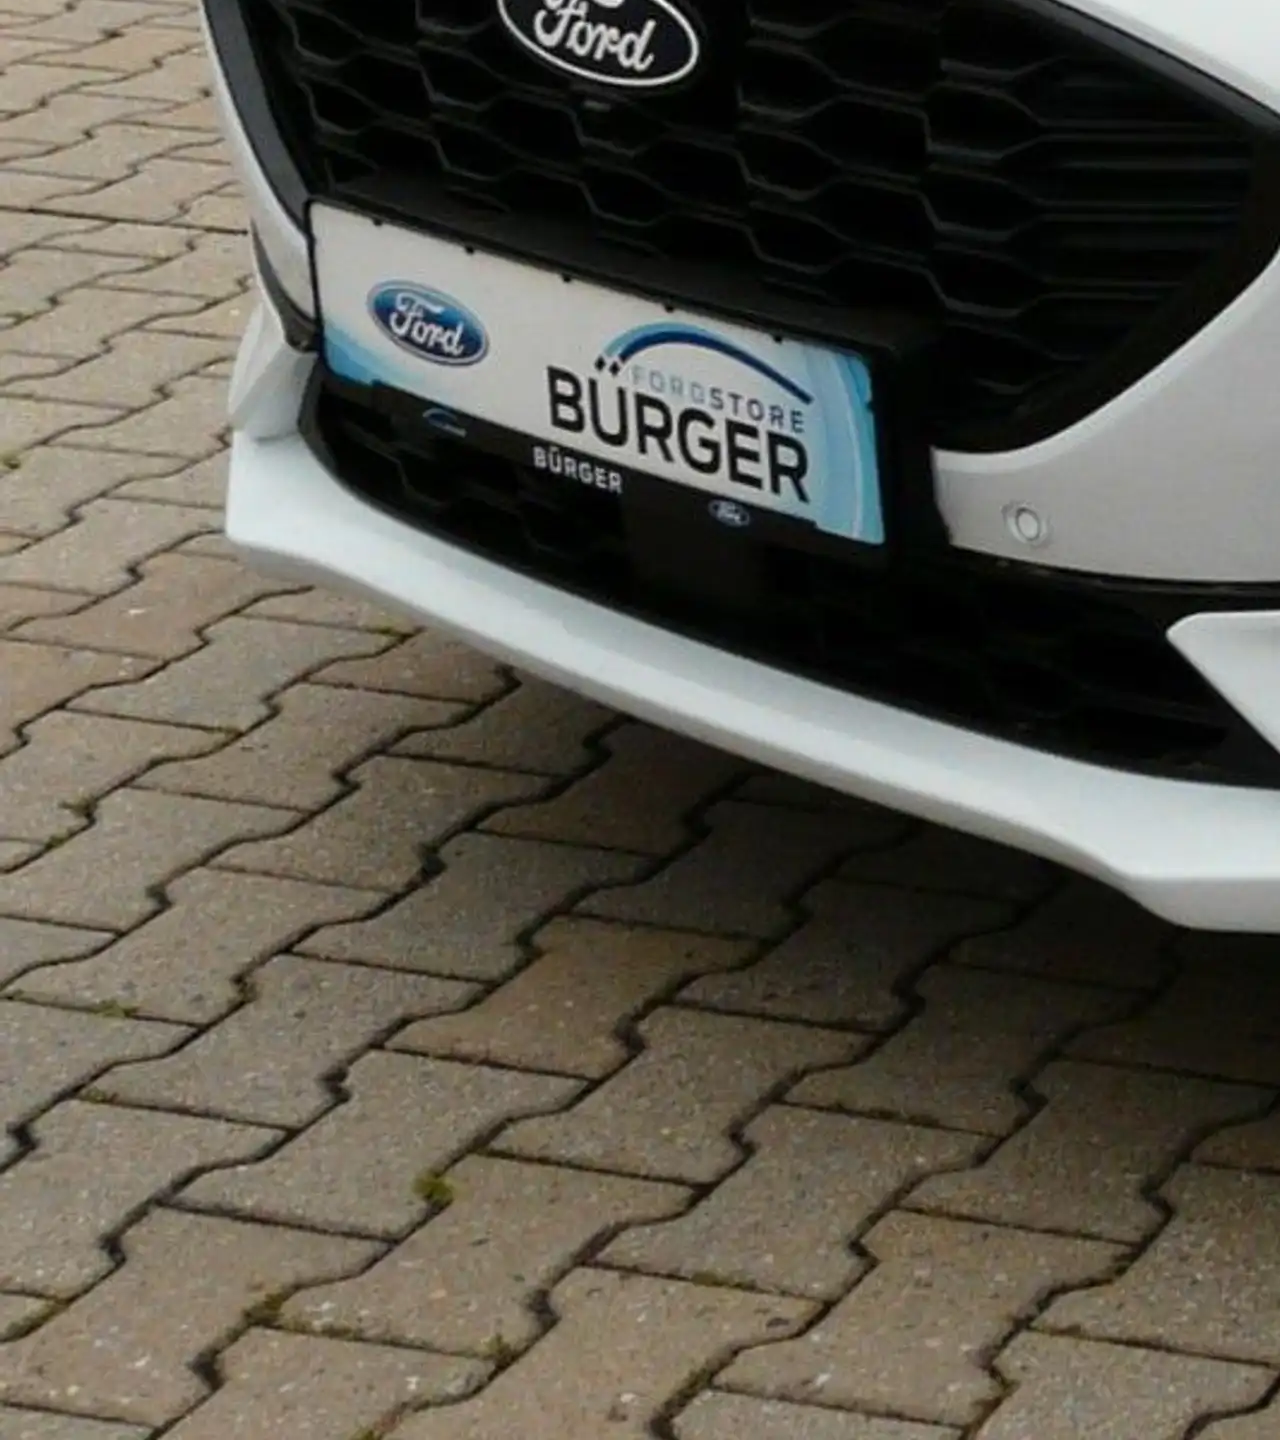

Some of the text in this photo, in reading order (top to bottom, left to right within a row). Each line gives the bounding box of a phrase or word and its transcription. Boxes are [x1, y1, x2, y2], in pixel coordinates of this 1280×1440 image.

[389, 291, 465, 356] Ford
[546, 355, 811, 504] BÜRGER
[631, 364, 805, 435] FORDSTORE
[533, 445, 623, 495] BÜRGER
